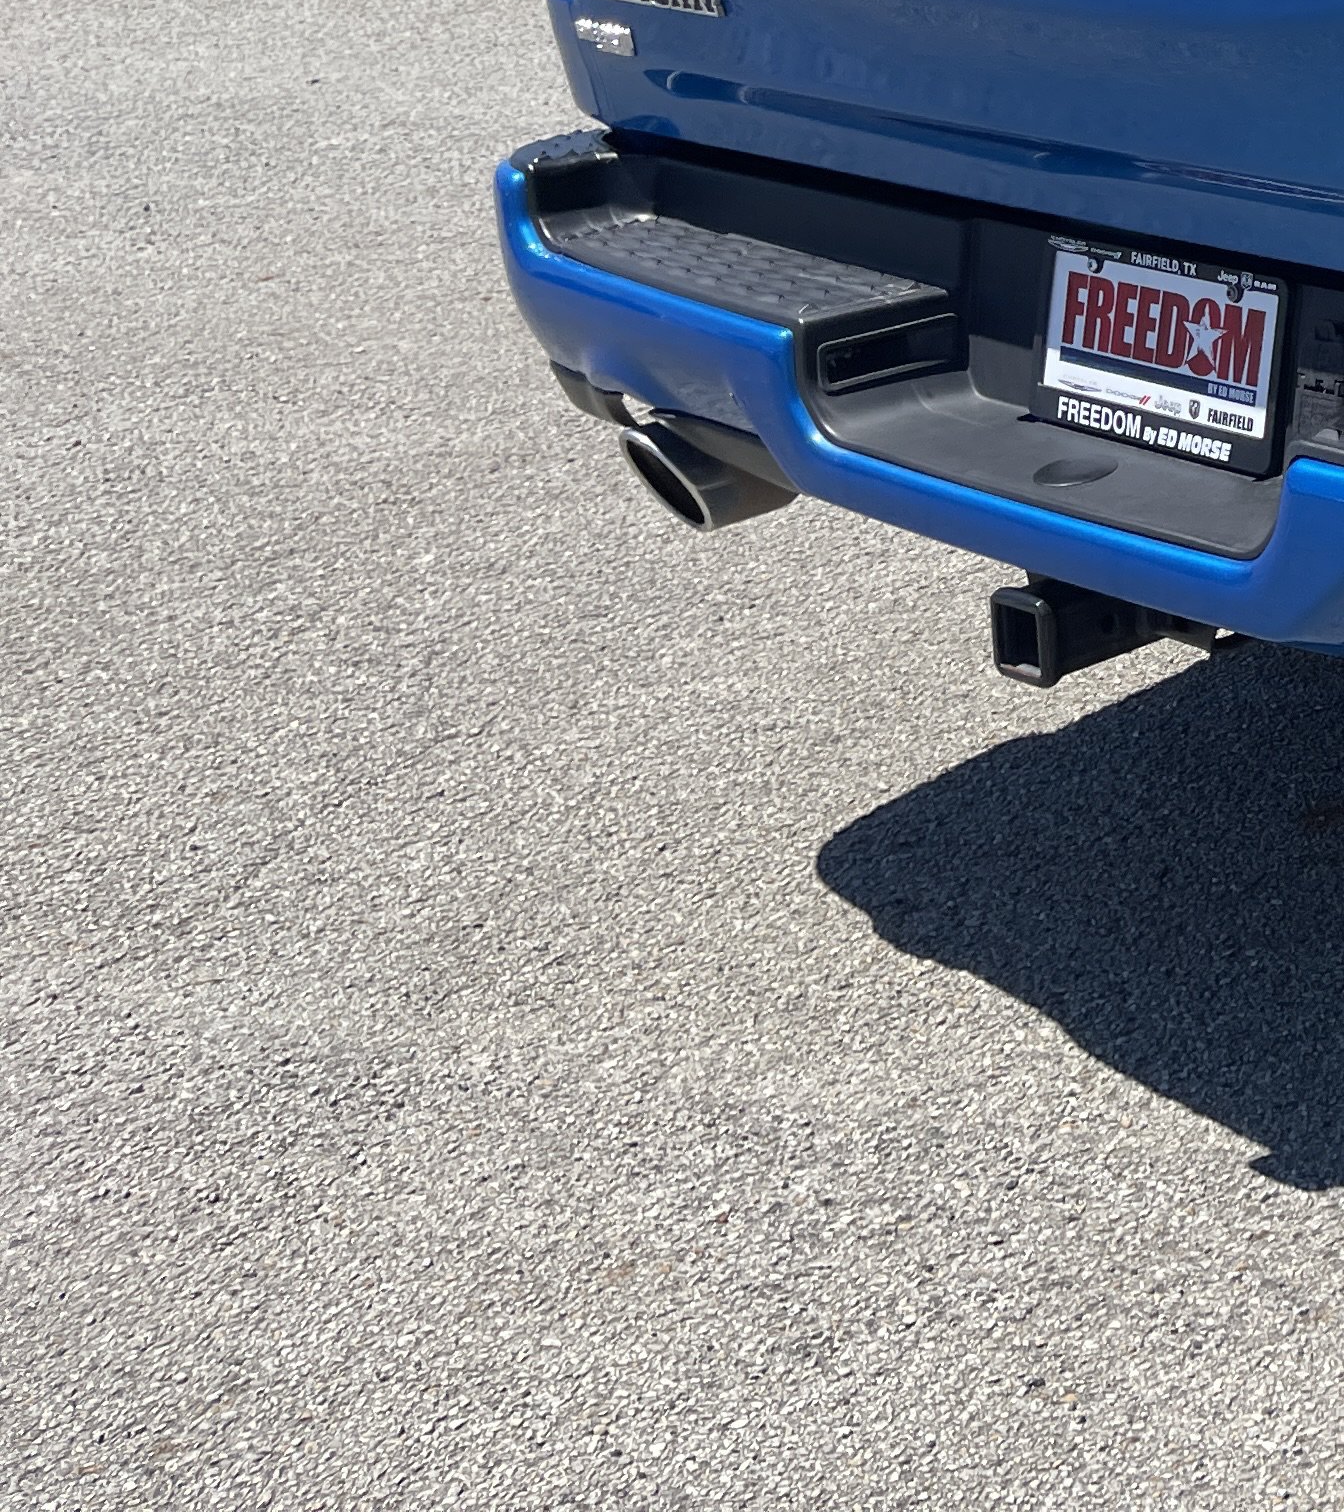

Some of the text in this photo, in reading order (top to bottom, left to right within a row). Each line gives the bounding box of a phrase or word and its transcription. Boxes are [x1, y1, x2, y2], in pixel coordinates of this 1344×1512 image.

[1131, 251, 1198, 276] FAIRFIELD, TX
[1217, 269, 1239, 285] Jeep
[1062, 271, 1267, 387] FREEDOM
[1218, 384, 1228, 397] ED
[1154, 394, 1182, 416] Jeep
[1057, 395, 1141, 439] FREEDOM
[1157, 426, 1178, 448] ED
[1178, 431, 1232, 462] MORSE
[1207, 407, 1254, 432] FAIRFIELD
